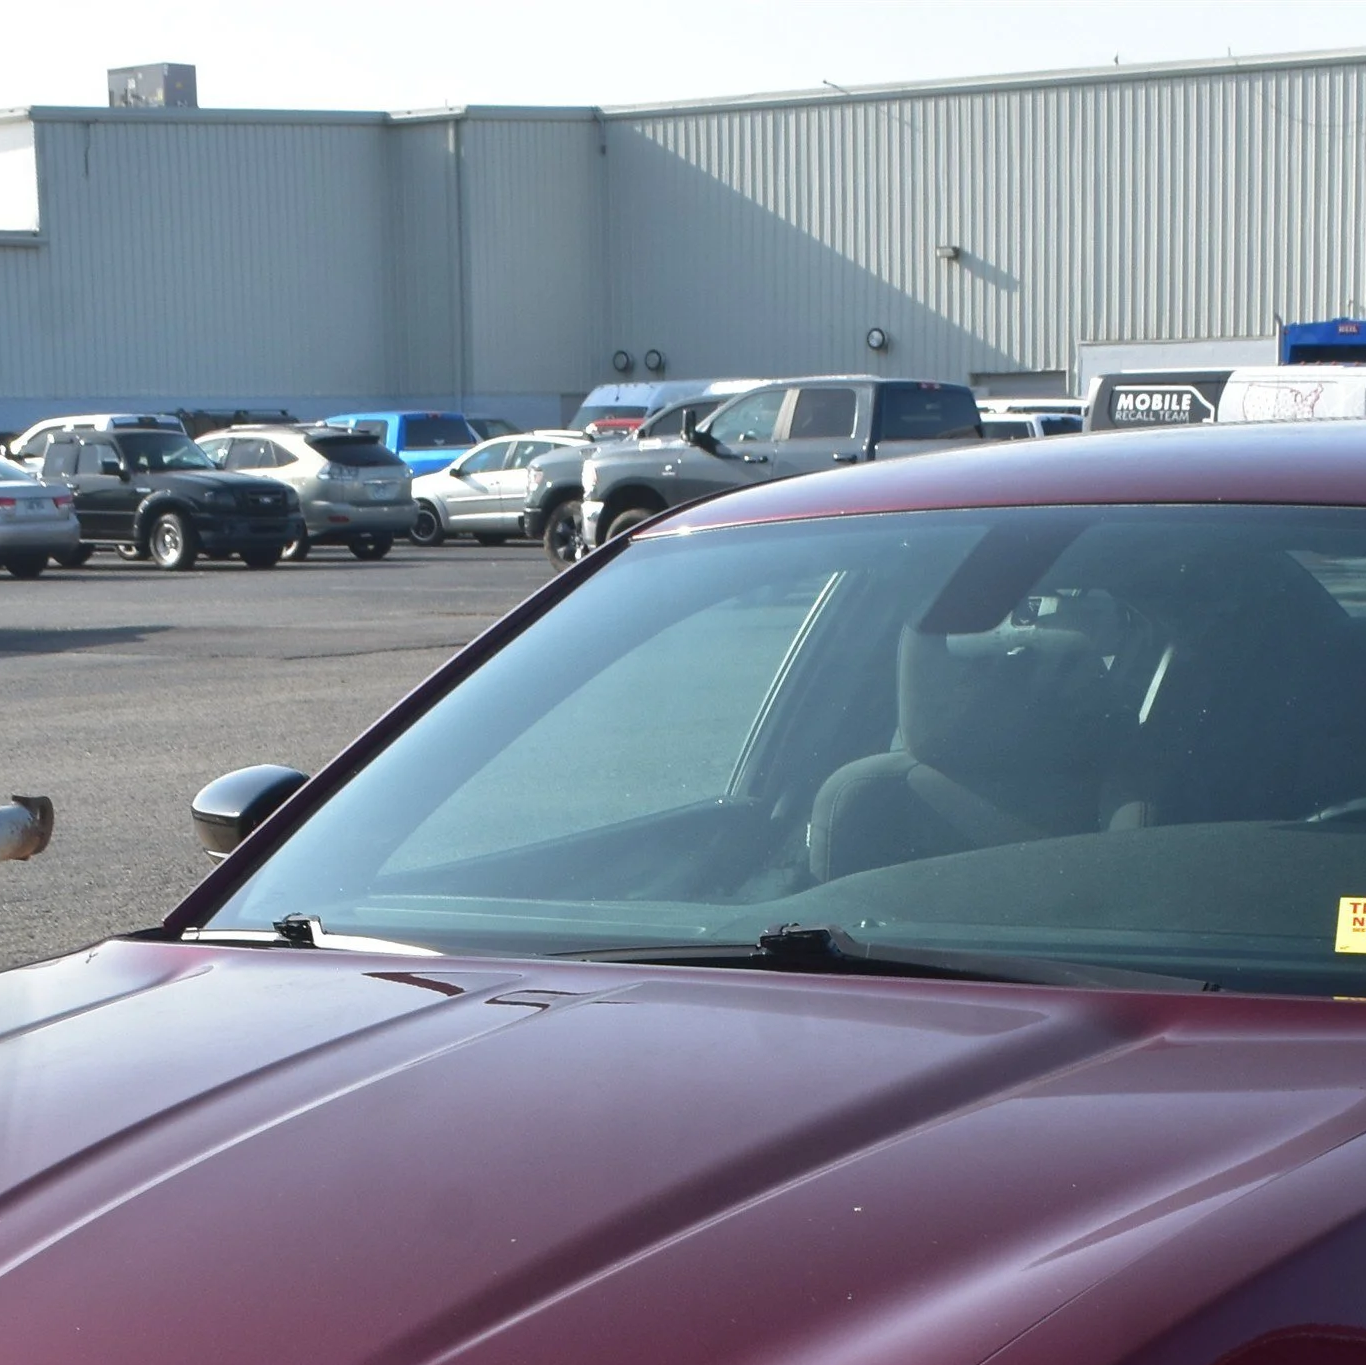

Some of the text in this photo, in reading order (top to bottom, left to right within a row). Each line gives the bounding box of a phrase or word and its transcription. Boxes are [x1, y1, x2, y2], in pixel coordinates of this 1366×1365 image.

[1116, 393, 1192, 411] MOBILE
[1115, 410, 1190, 422] RECALL TEAM
